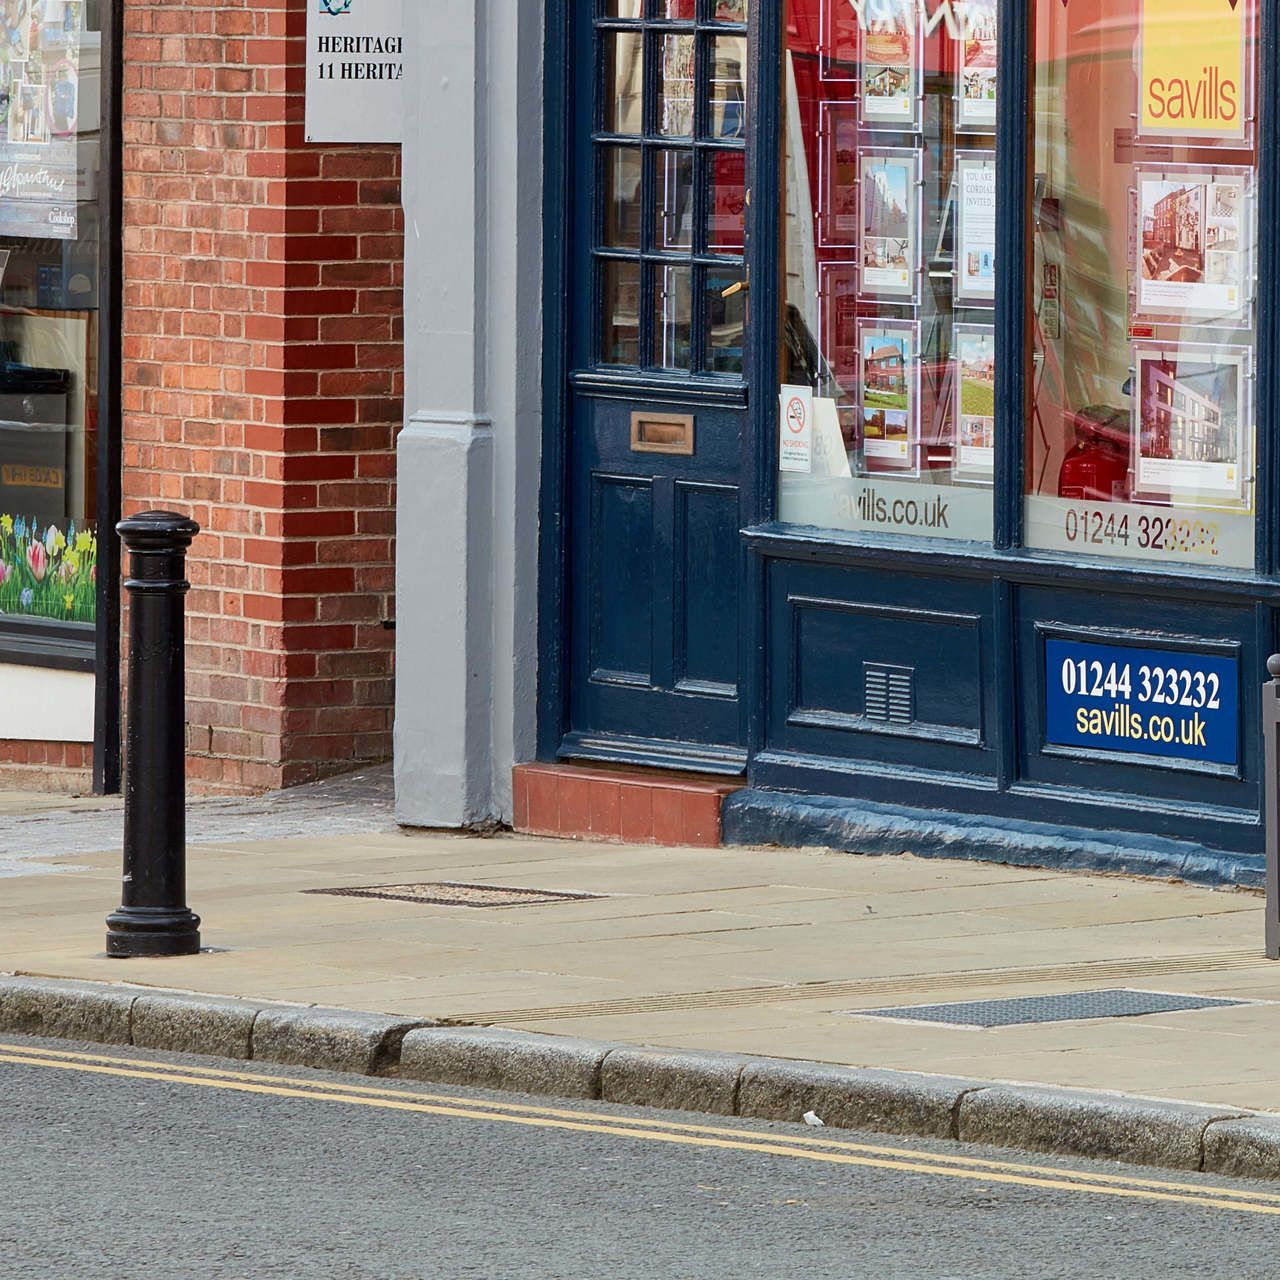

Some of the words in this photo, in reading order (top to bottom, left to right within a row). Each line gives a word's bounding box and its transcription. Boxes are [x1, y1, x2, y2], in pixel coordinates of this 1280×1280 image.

[318, 63, 334, 79] 11
[1148, 66, 1236, 121] savills
[1065, 509, 1130, 547] 01244
[1062, 658, 1131, 699] 01244
[1138, 665, 1220, 710] 323232
[1076, 703, 1207, 747] savills.co.uk
